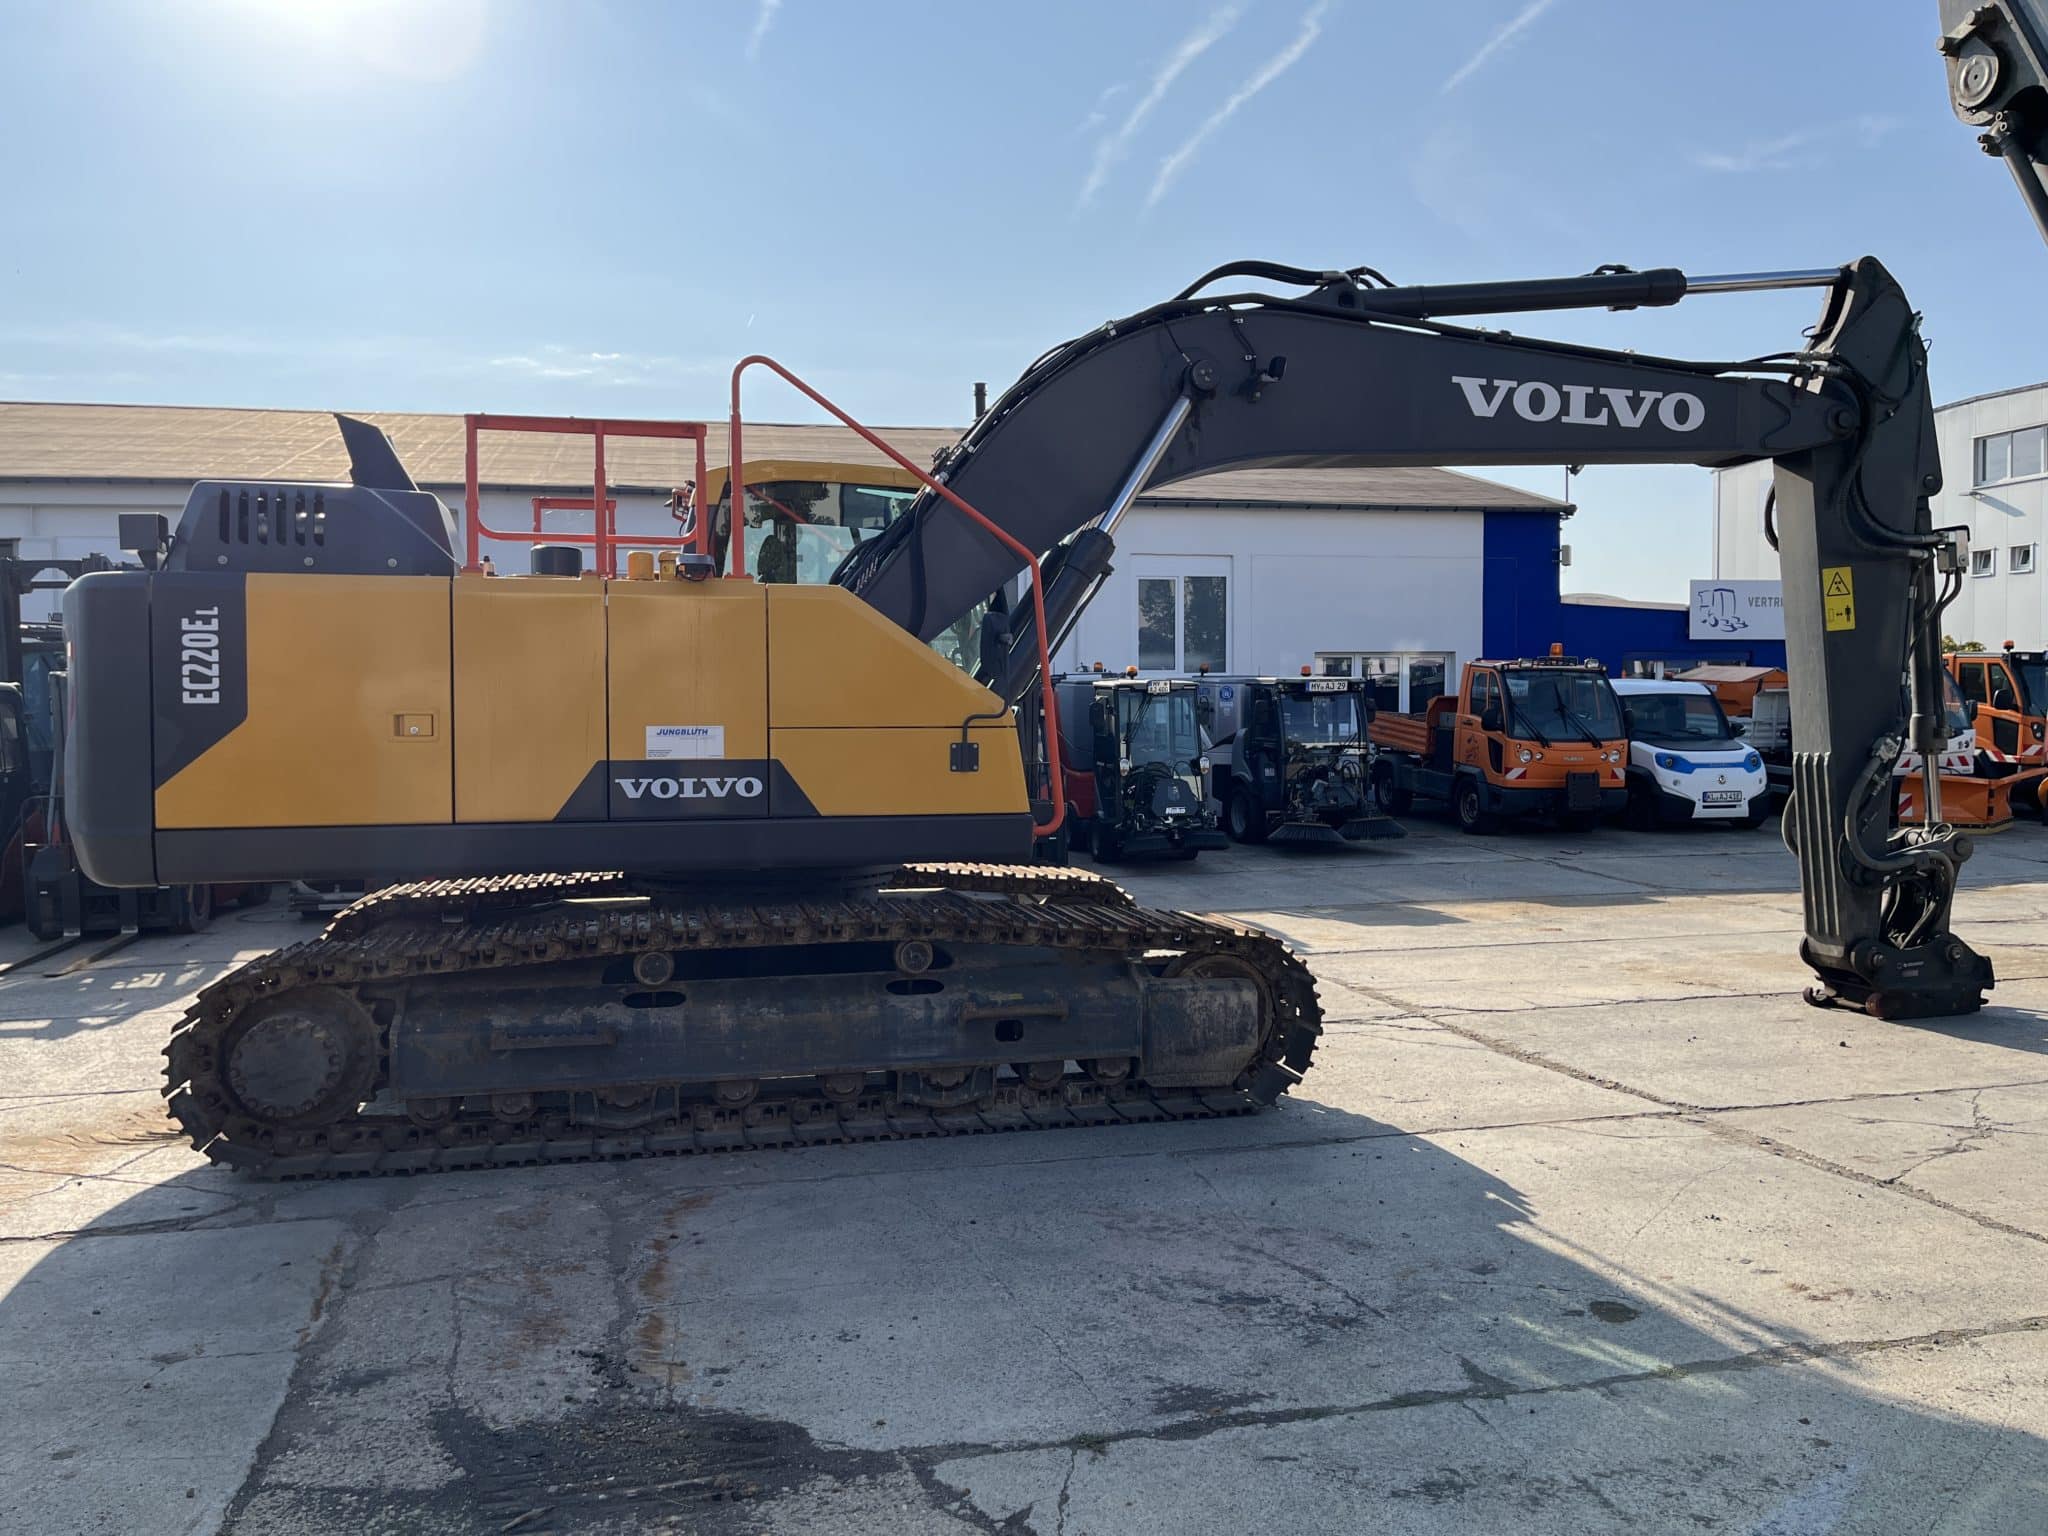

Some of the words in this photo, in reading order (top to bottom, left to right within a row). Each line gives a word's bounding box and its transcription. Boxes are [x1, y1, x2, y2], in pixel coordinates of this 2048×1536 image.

[1452, 375, 1706, 432] VOLVO
[181, 606, 220, 704] EC220EL
[656, 728, 709, 736] JUNGBLUTH
[615, 776, 763, 799] VOLVO
